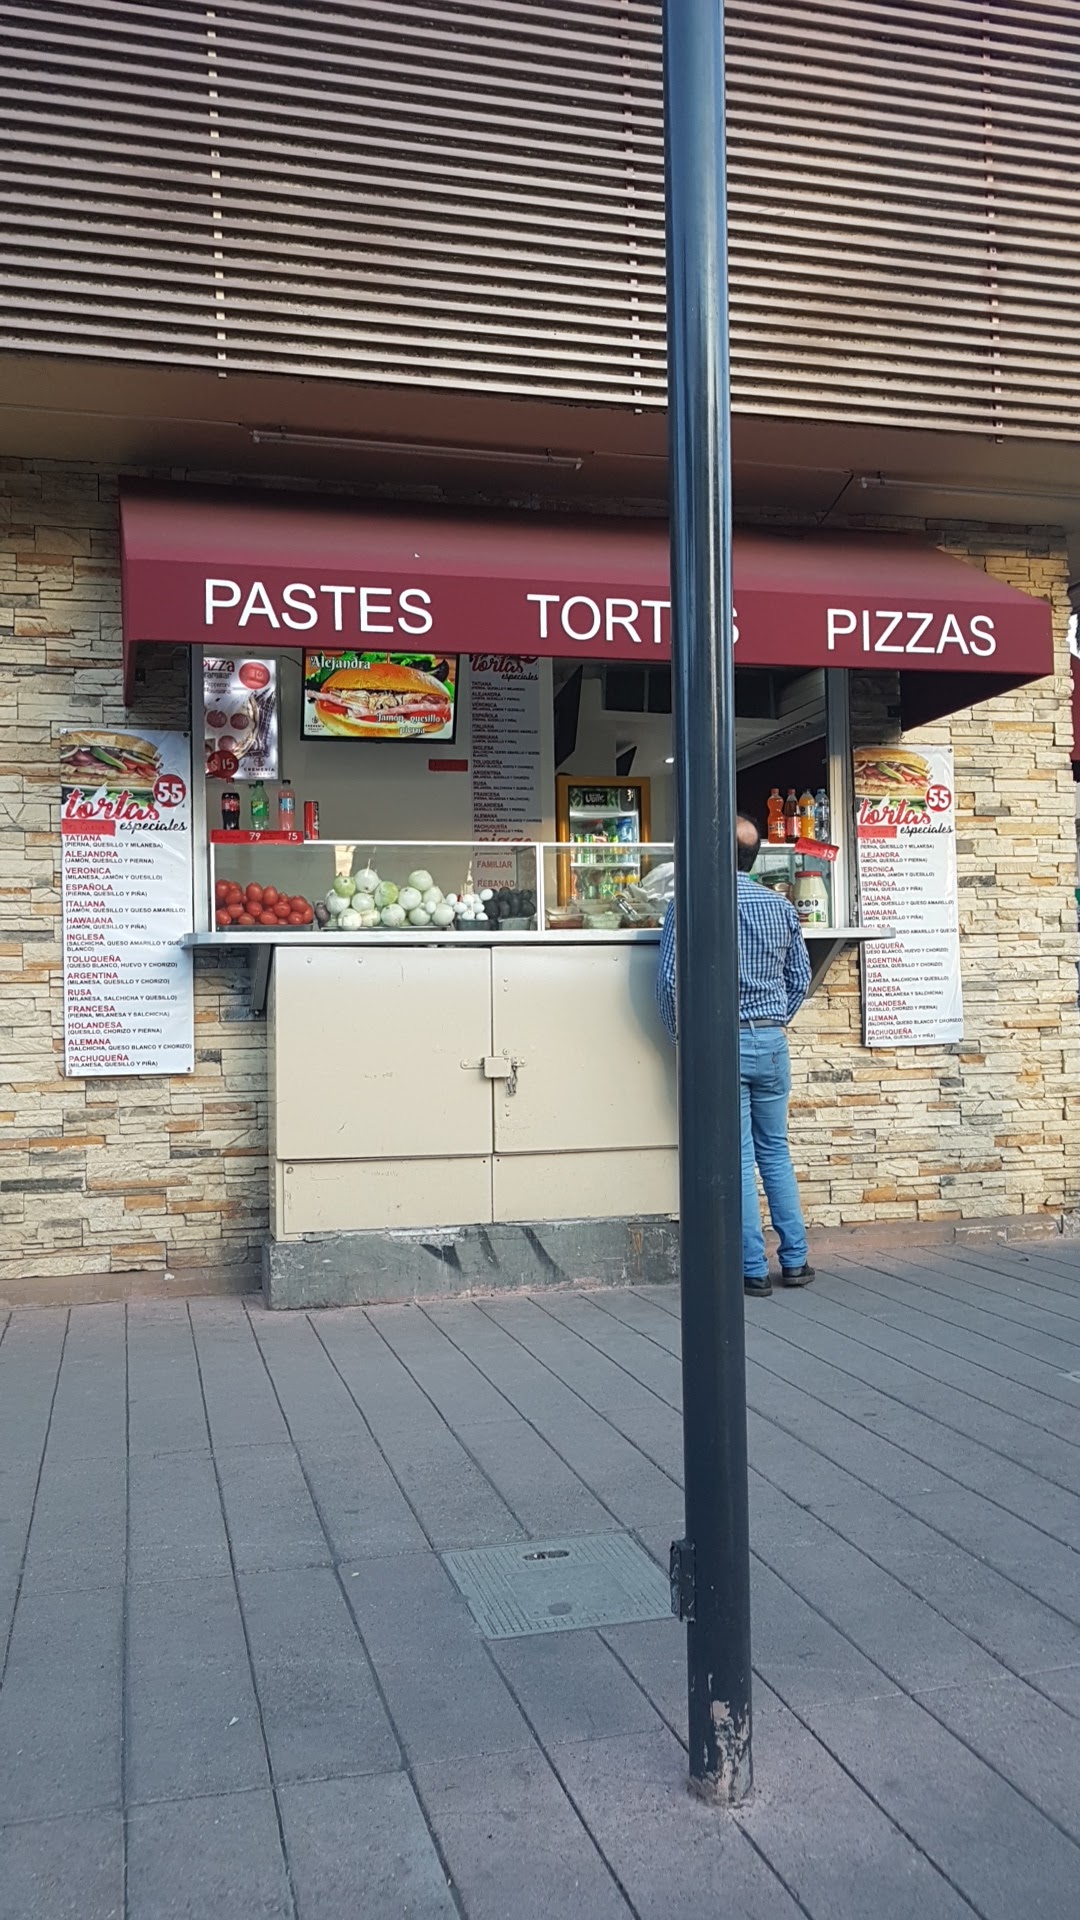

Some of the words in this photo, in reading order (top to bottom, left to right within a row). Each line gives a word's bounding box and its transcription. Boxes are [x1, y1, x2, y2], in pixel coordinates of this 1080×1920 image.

[205, 578, 433, 635] PASTES
[526, 593, 740, 645] TORT
[826, 608, 997, 657] PIZZAS
[310, 655, 370, 670] Alejandra
[472, 654, 523, 673] tortas
[502, 672, 538, 682] especiales
[376, 713, 406, 723] Jamón,
[157, 782, 183, 803] 55
[928, 789, 950, 807] 55
[65, 789, 160, 820] tortas
[860, 799, 931, 825] tortas
[120, 819, 187, 834] especiales
[900, 823, 954, 837] especiales
[249, 832, 261, 840] 79
[288, 832, 298, 840] 15
[822, 849, 834, 859] 15
[69, 1054, 129, 1062] PACHUQUEÑA
